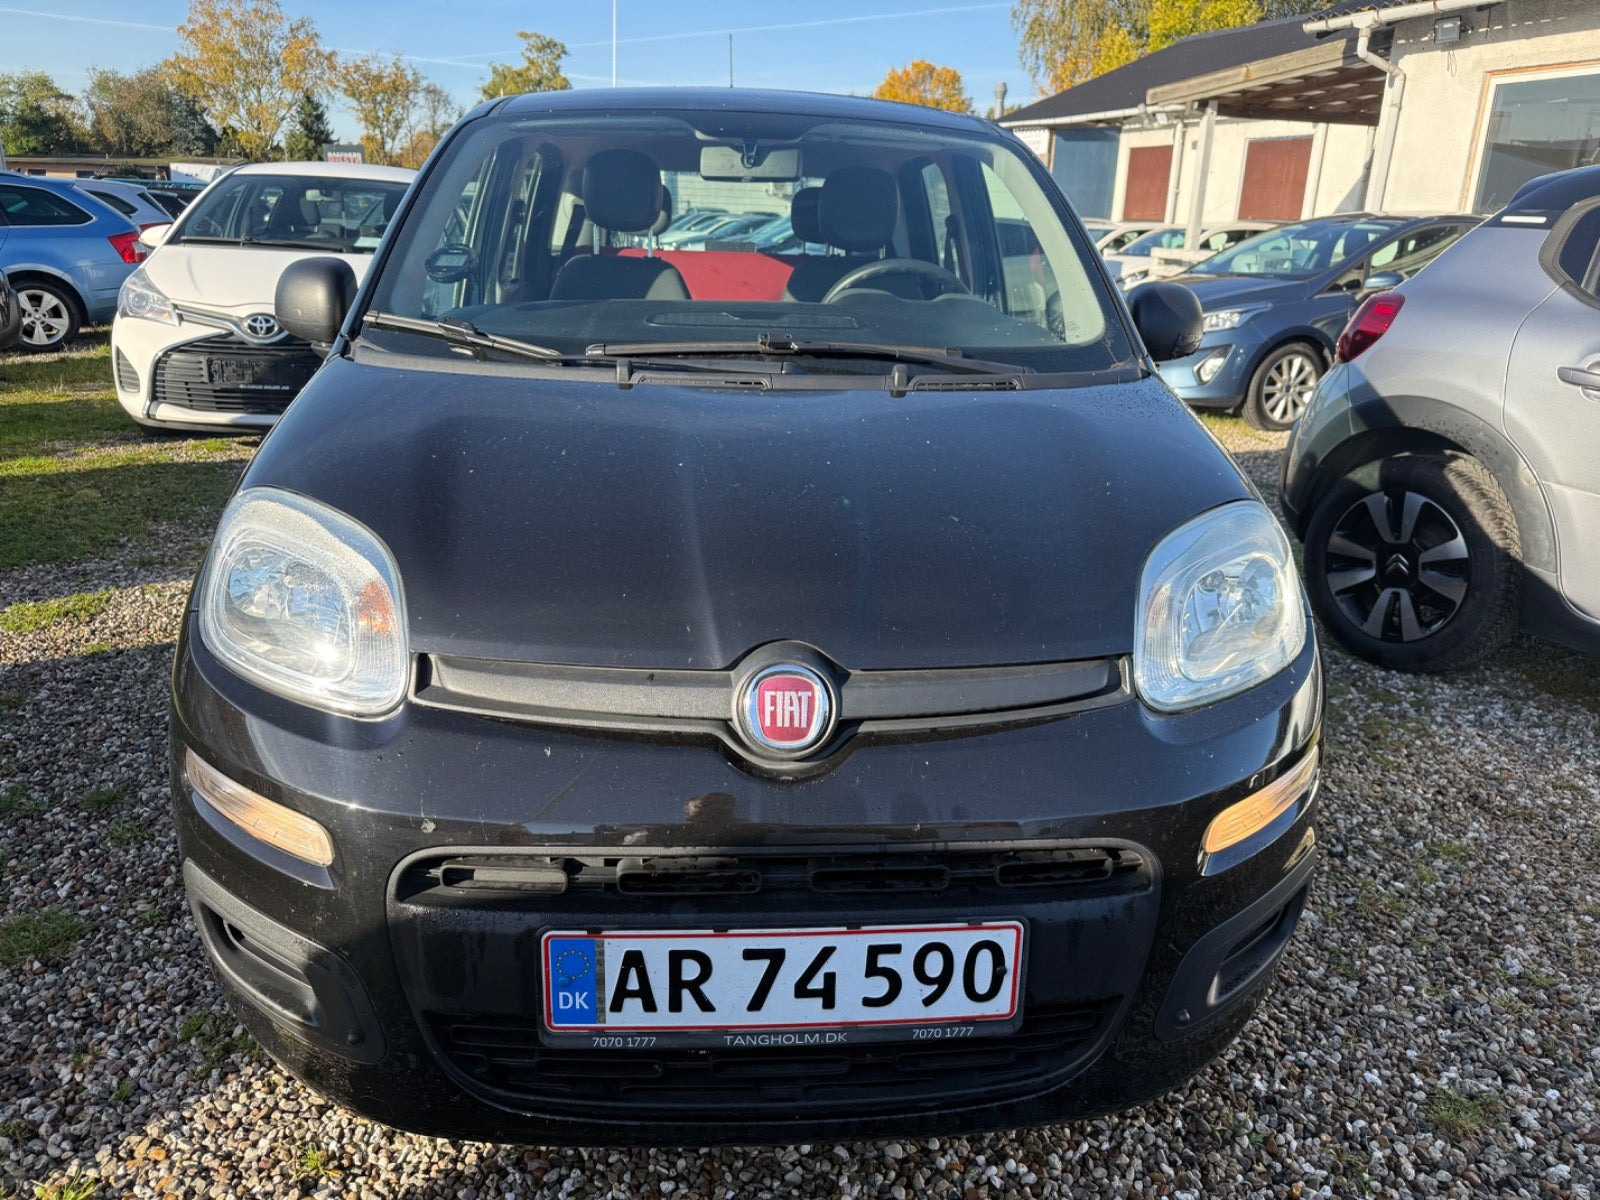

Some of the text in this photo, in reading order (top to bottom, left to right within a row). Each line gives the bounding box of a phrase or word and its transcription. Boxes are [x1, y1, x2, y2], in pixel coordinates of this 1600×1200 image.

[764, 690, 812, 728] FIAT
[609, 940, 1006, 1013] AR 74 590
[558, 991, 589, 1010] DK
[723, 1032, 848, 1046] TANGHOLM.DK
[912, 1026, 974, 1040] 7070 1777
[592, 1036, 657, 1047] 7070 1777
